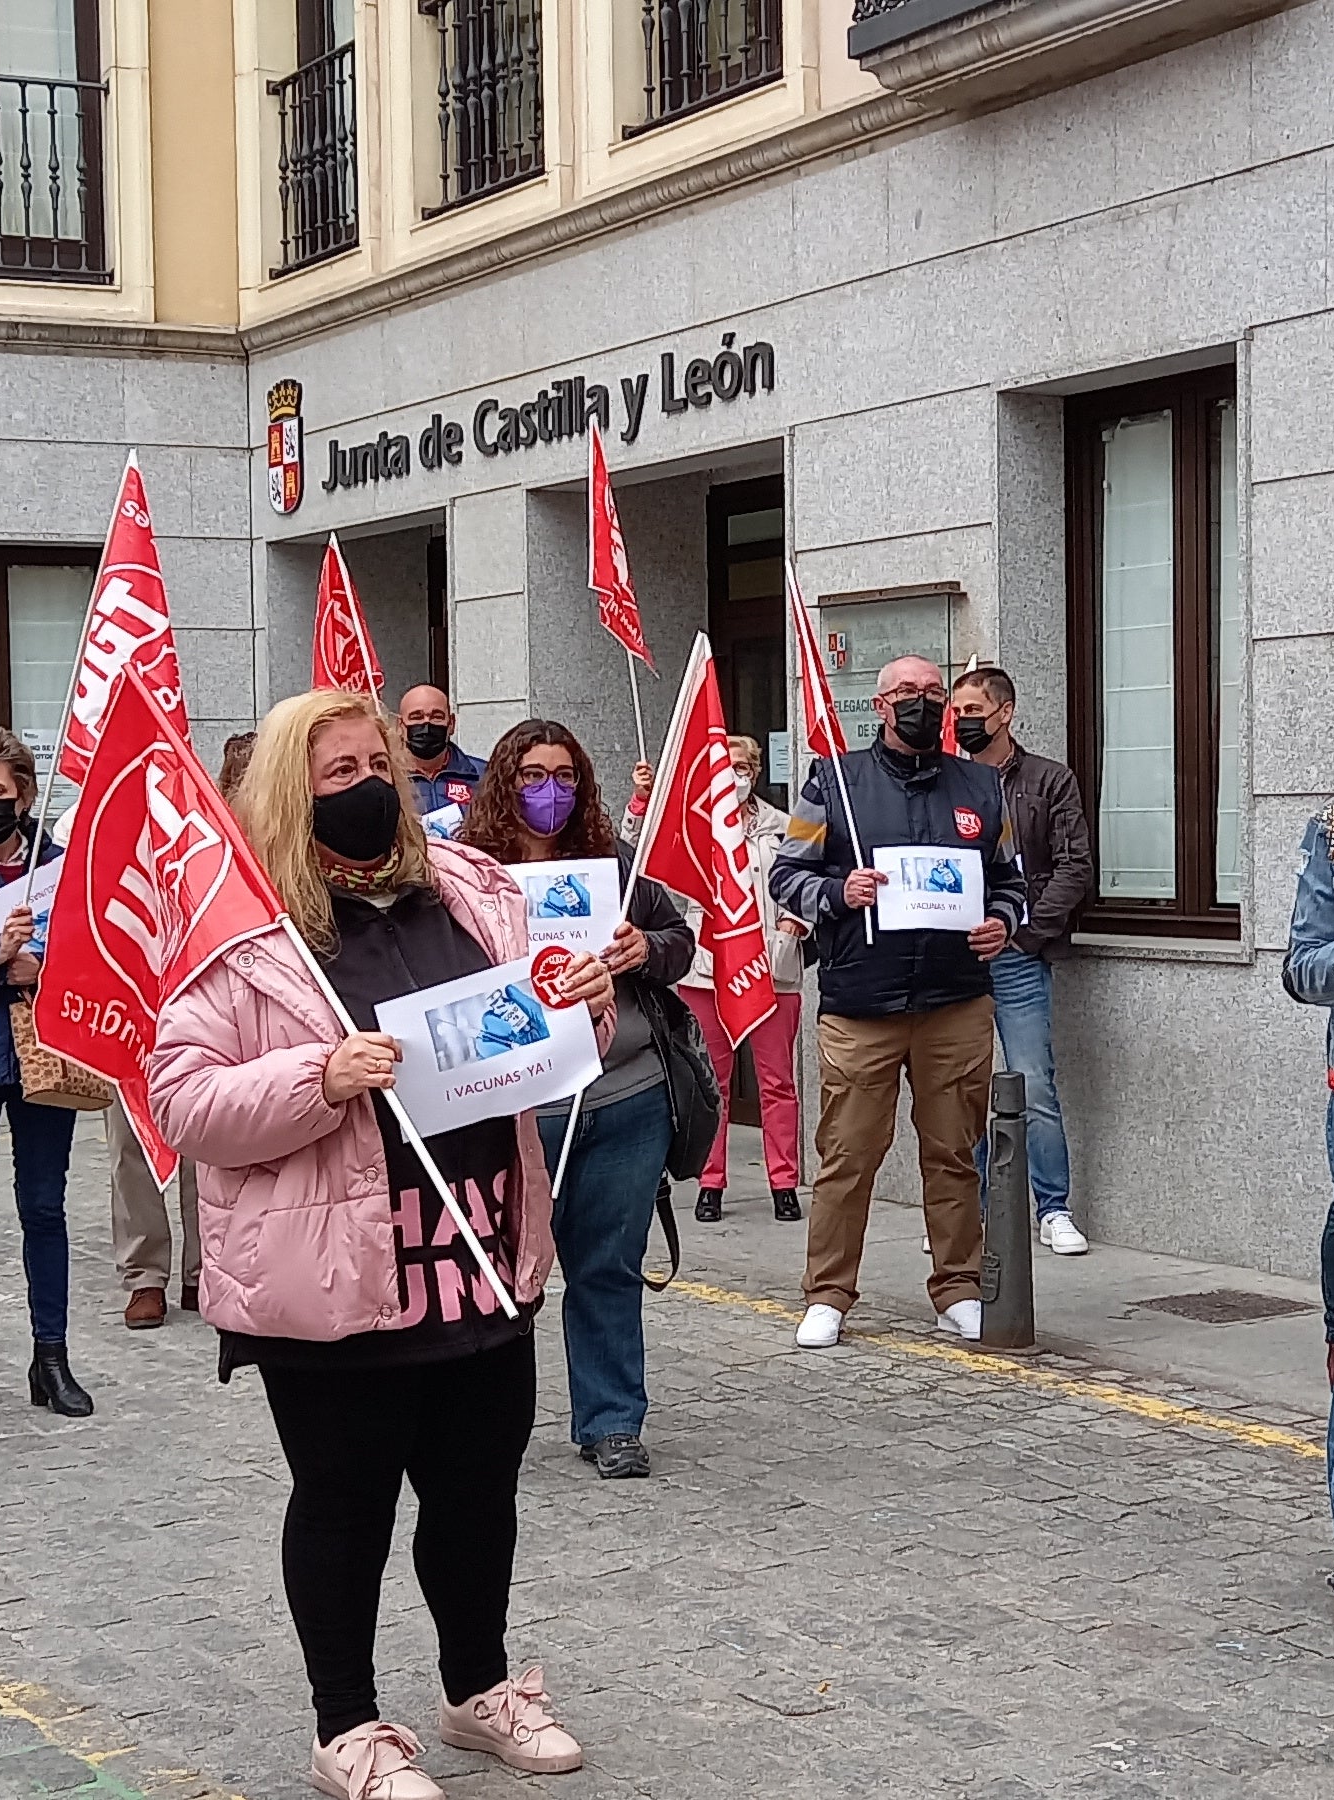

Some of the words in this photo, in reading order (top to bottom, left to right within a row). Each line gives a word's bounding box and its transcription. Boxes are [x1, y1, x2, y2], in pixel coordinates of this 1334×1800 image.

[322, 432, 410, 493] Junta
[419, 414, 463, 471] de
[473, 376, 609, 457] Castilla
[620, 374, 649, 443] y
[660, 332, 775, 416] León
[858, 724, 869, 737] DE
[910, 902, 946, 911] VACUNAS
[569, 931, 582, 939] YA
[453, 1071, 521, 1095] VACUNAS
[526, 1062, 545, 1079] YA
